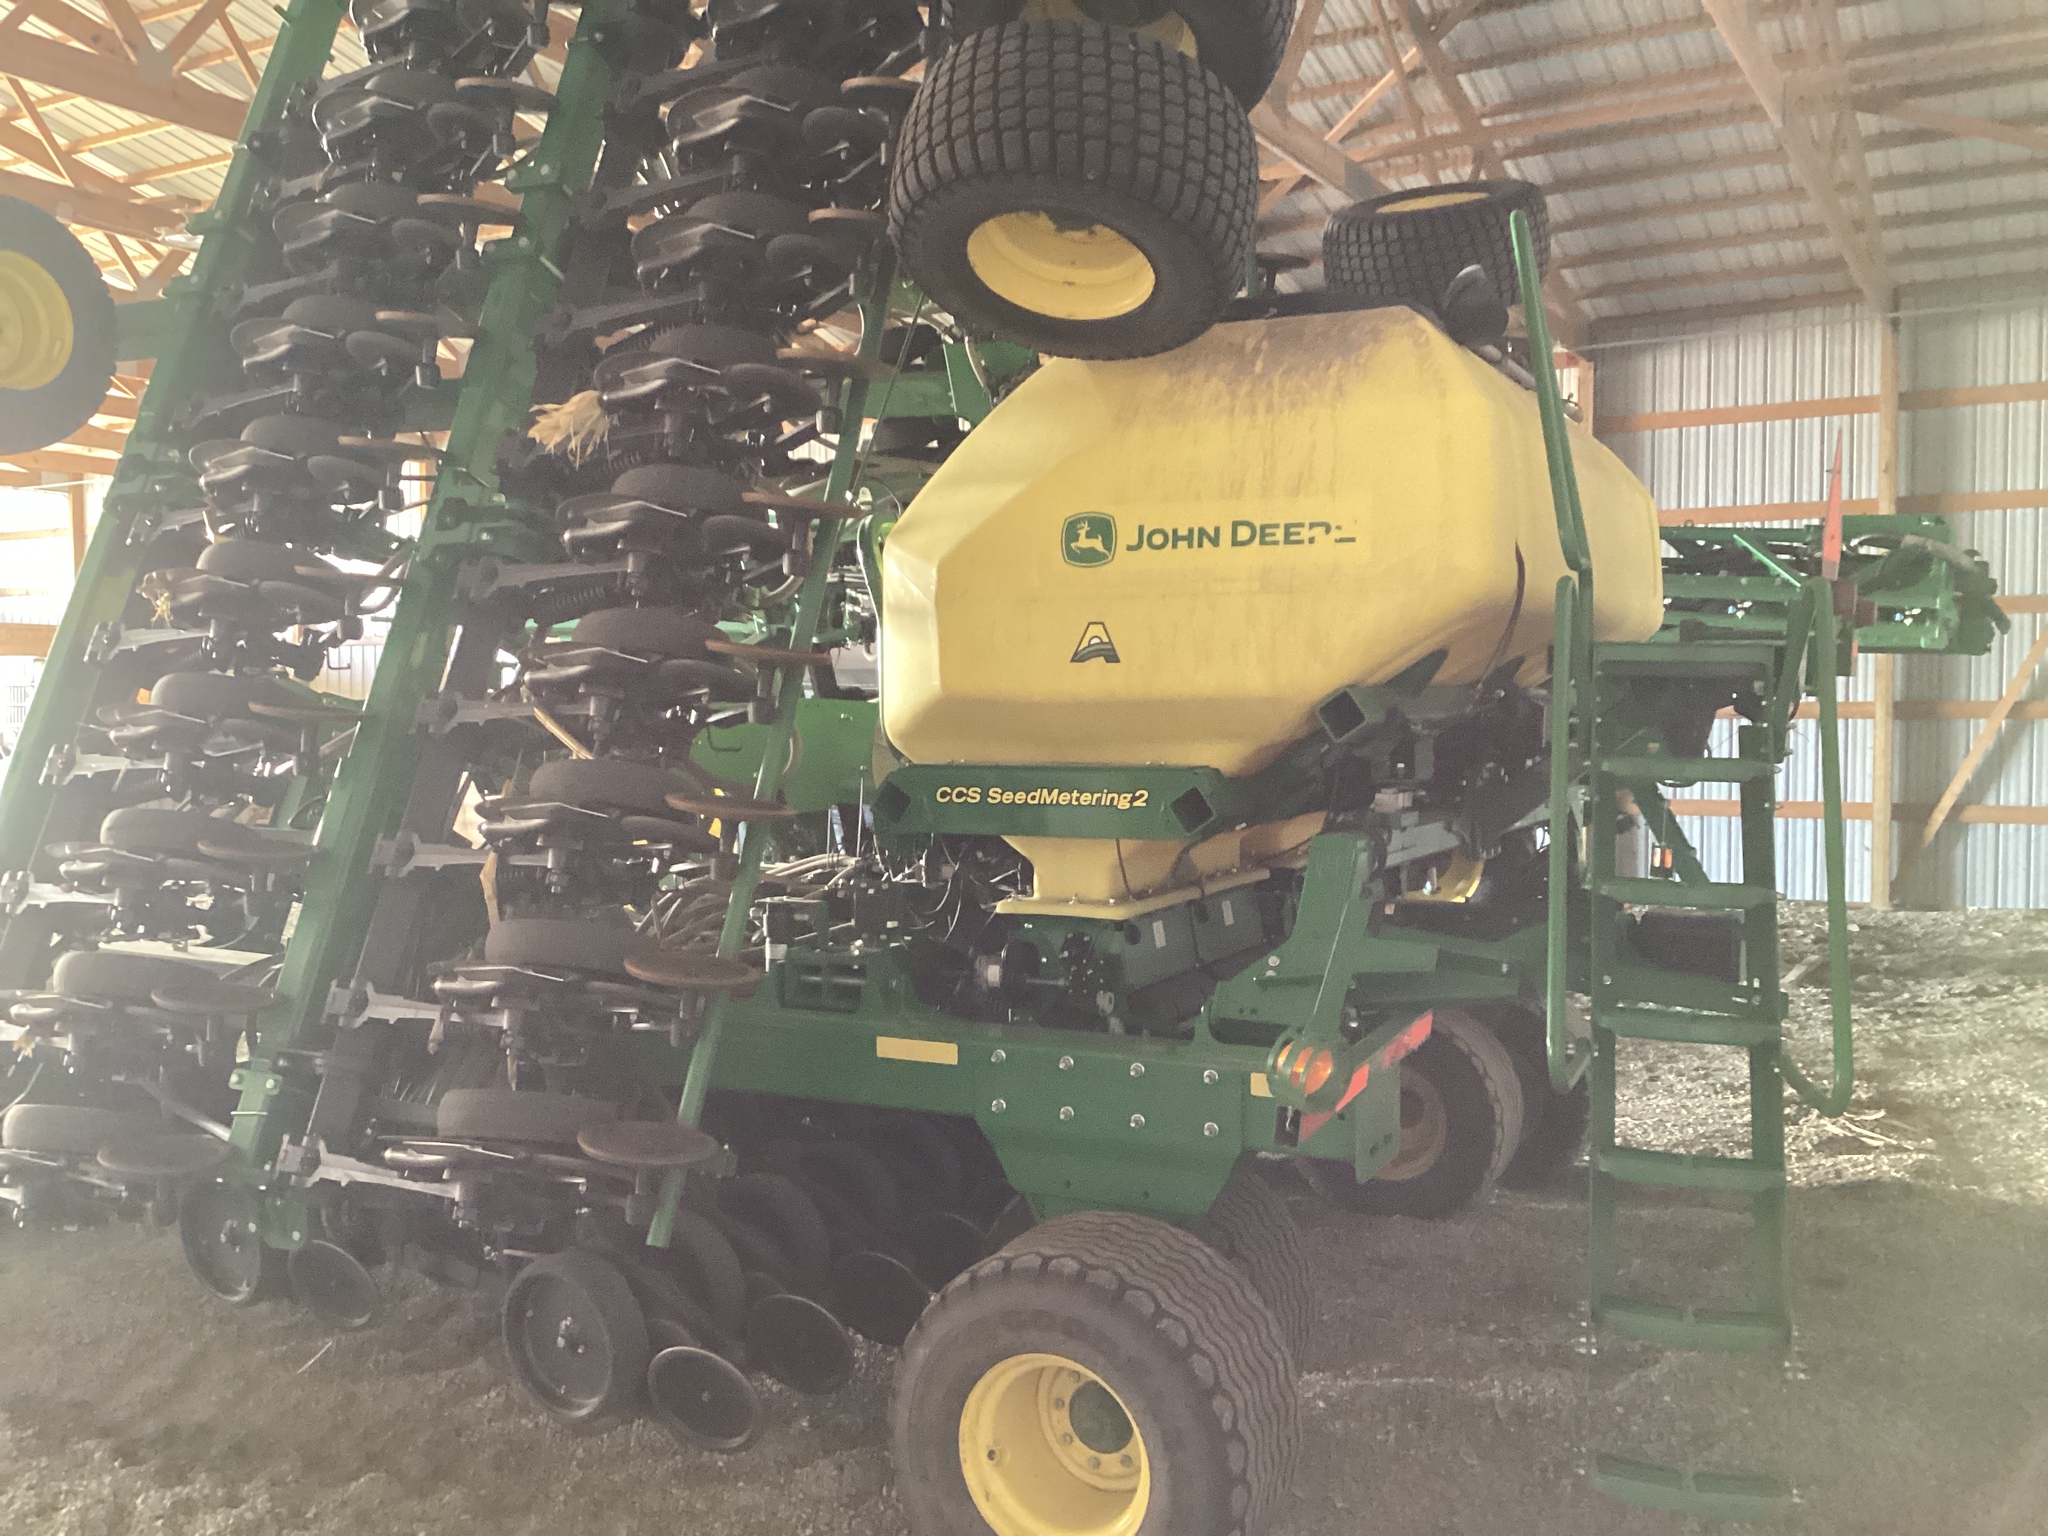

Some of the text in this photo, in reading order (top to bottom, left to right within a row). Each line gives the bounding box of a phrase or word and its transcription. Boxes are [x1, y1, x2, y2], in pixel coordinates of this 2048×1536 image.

[1126, 524, 1221, 551] JOHN
[936, 786, 1149, 810] CCS SeedMetering2
